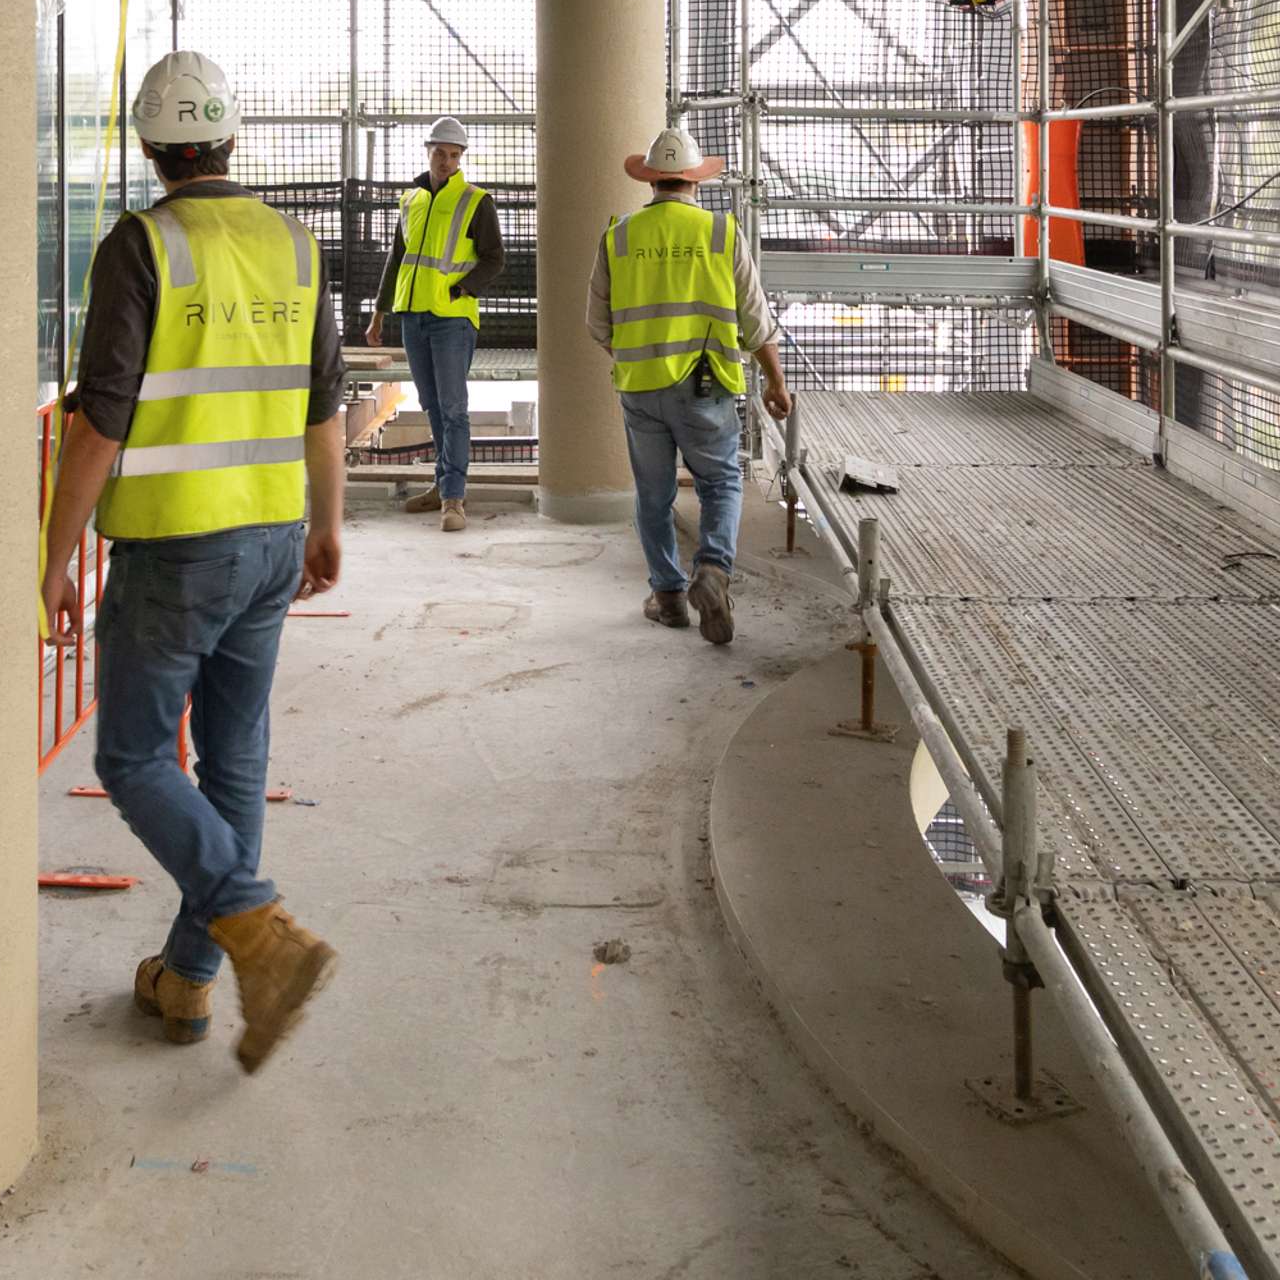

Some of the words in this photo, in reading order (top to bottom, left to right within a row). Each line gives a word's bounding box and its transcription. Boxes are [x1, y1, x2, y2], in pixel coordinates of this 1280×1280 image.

[178, 100, 199, 122] R
[665, 148, 676, 161] R
[185, 294, 301, 326] RIVIÈRE
